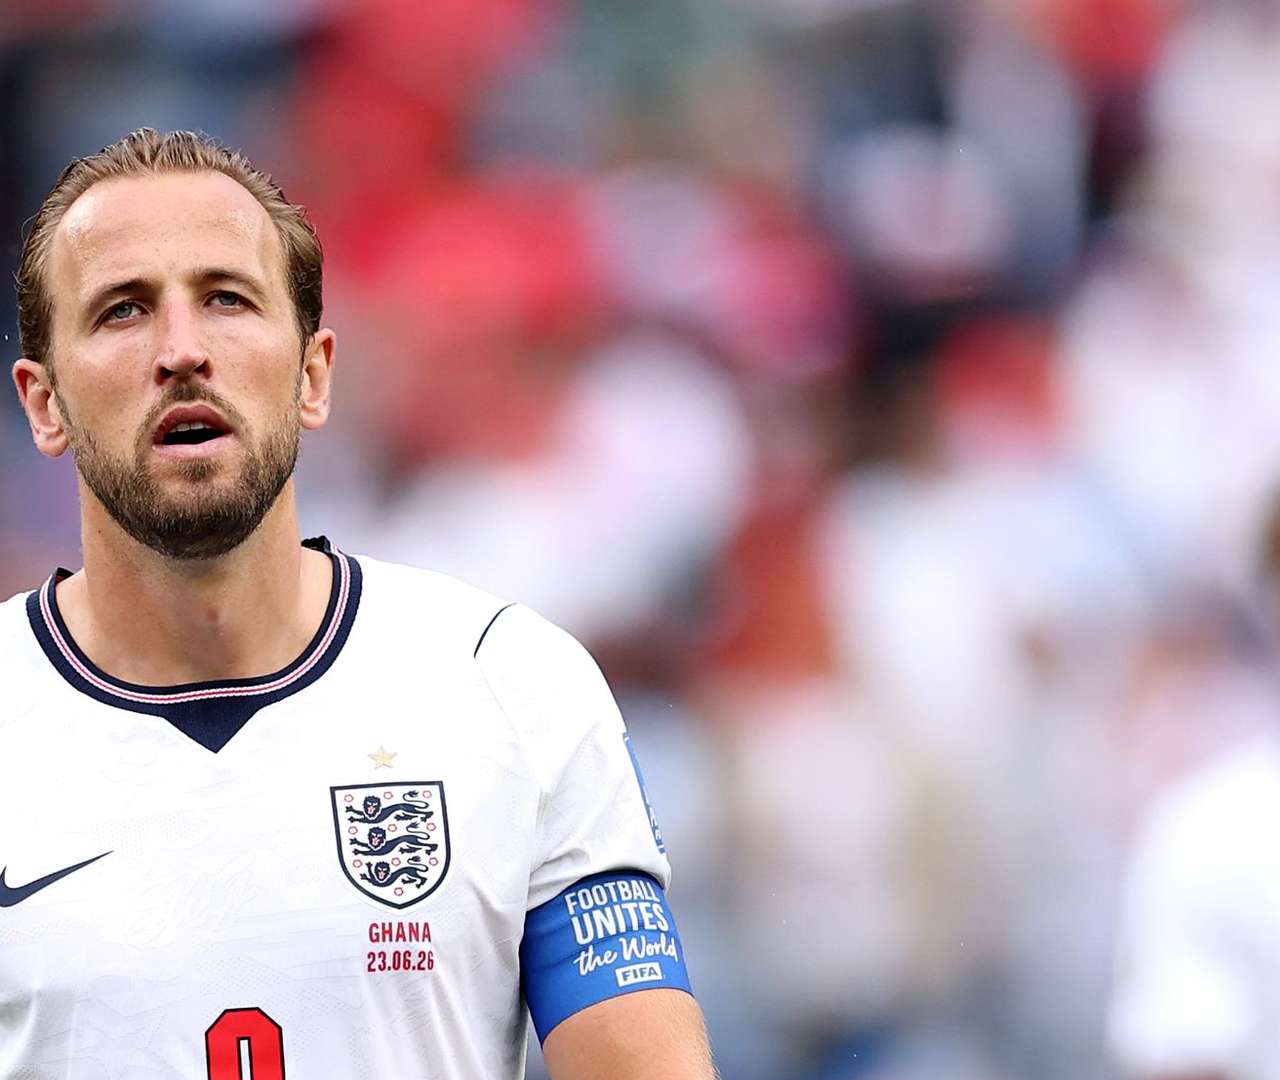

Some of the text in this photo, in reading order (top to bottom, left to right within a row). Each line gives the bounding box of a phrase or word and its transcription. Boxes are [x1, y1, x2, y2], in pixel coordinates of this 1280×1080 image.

[565, 880, 661, 914] FOOTBALL
[368, 922, 431, 942] GHANA
[570, 901, 669, 945] UNITES
[367, 950, 434, 972] 23.06.26
[573, 933, 679, 976] the World
[620, 965, 659, 982] FIFA
